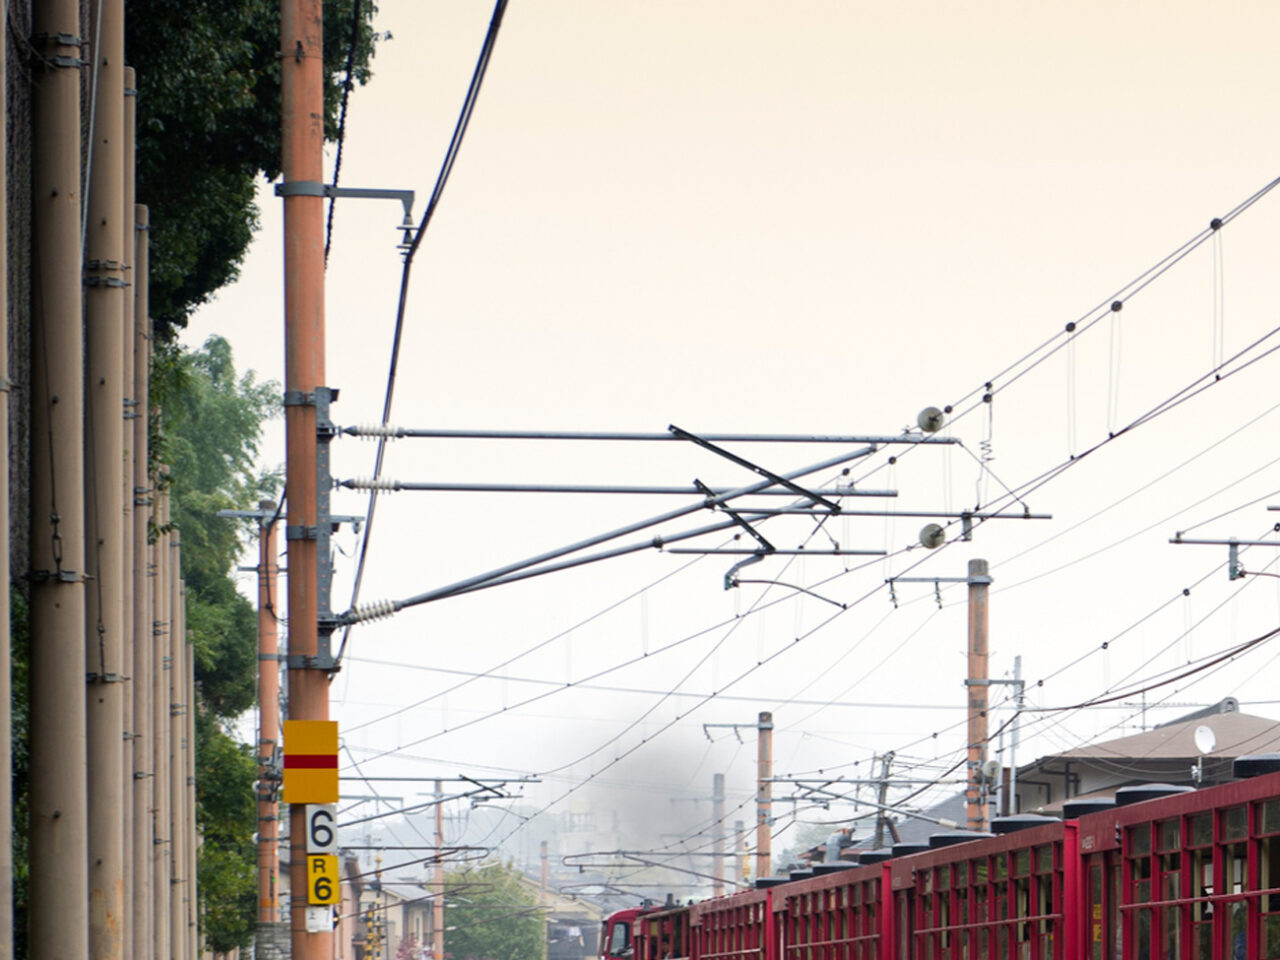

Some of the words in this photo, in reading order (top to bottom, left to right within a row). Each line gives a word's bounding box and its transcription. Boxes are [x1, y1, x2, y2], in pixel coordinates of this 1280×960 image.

[311, 810, 333, 847] 6
[313, 858, 326, 873] R
[314, 877, 332, 900] 6
